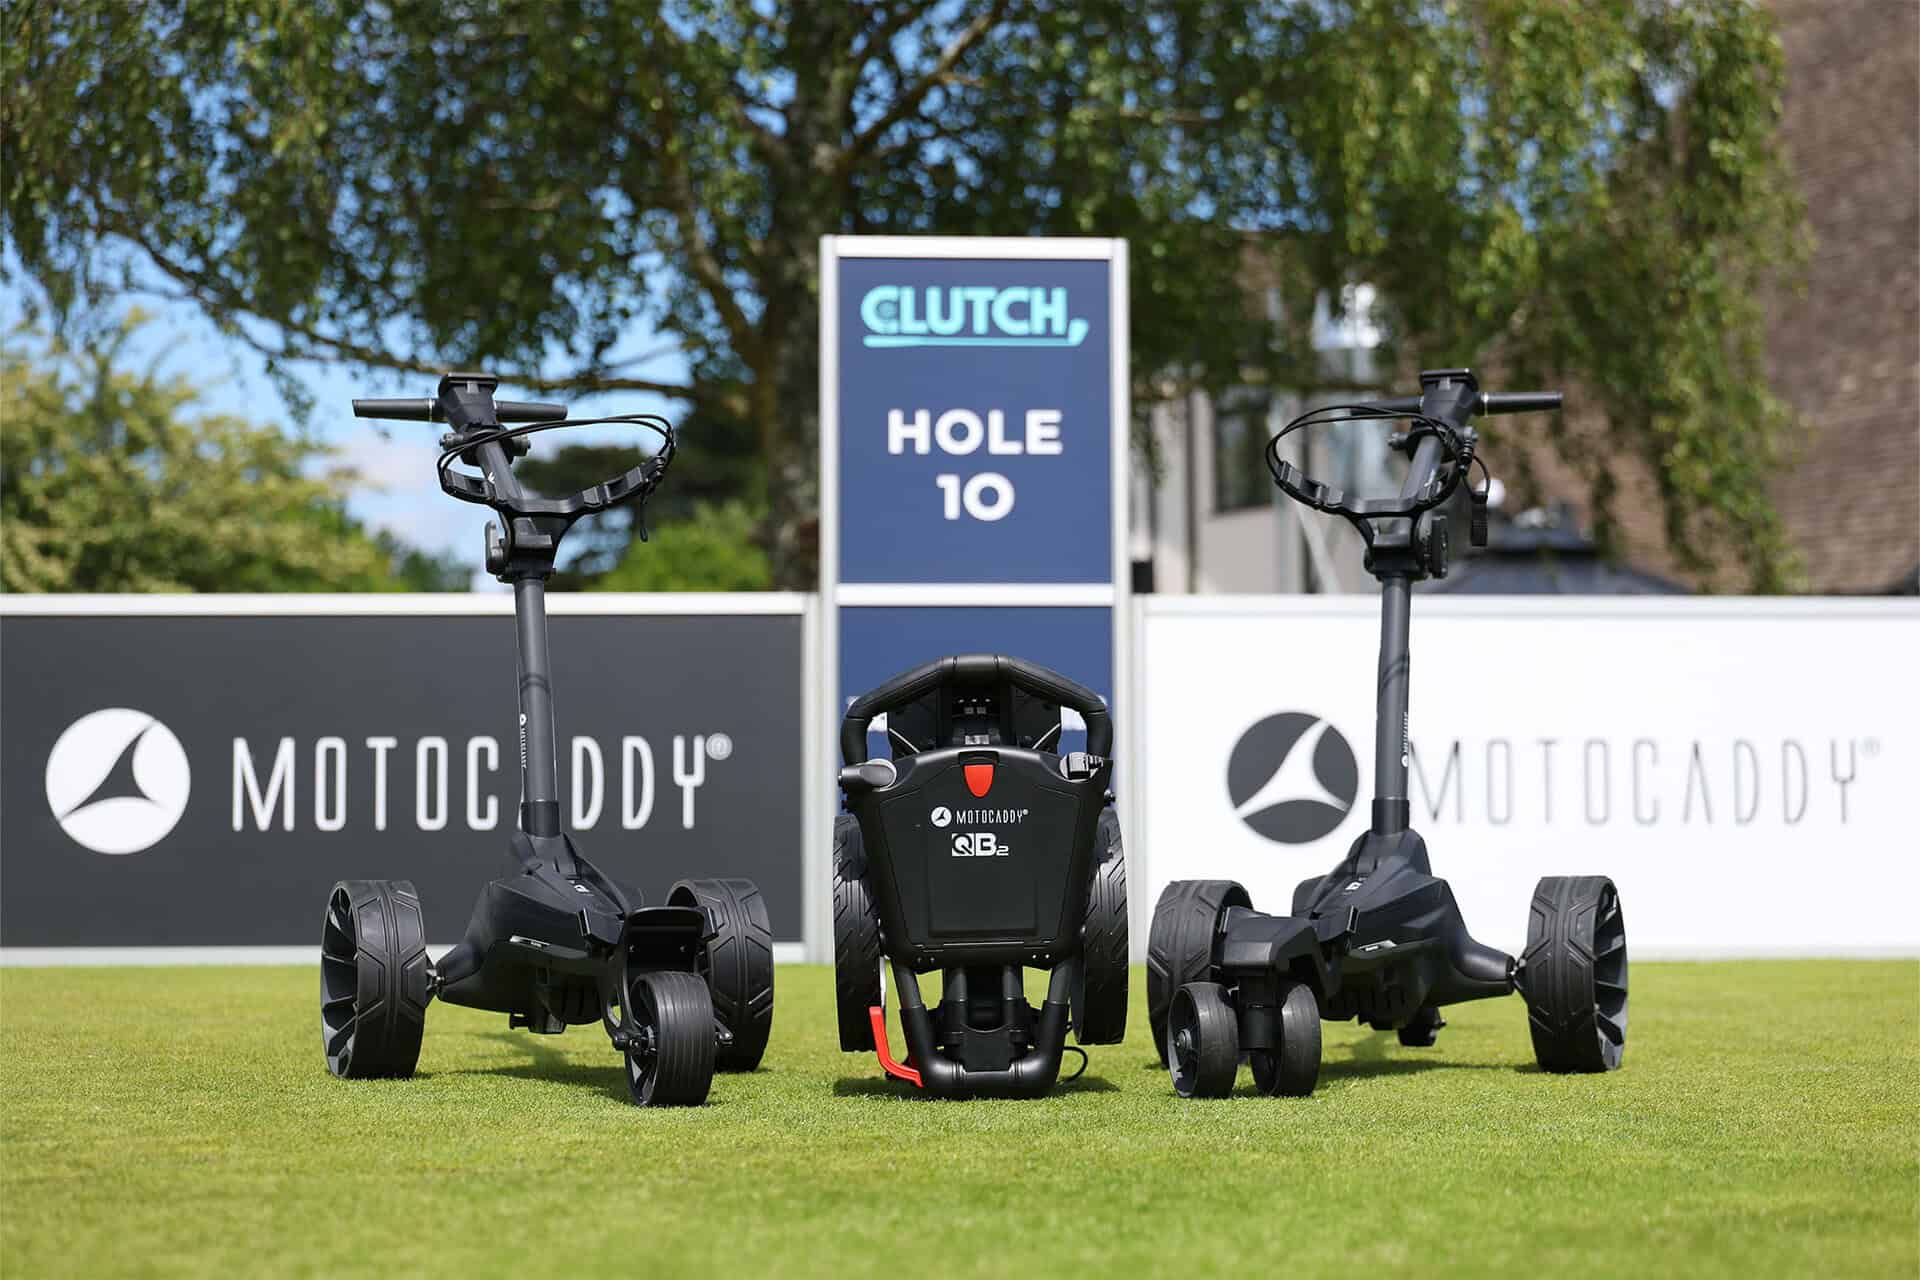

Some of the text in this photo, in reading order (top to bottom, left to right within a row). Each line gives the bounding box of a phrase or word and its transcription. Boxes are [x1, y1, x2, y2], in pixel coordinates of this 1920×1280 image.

[888, 409, 1063, 455] HOLE
[936, 472, 1015, 521] 10
[231, 735, 705, 830] MOTOCDDY
[956, 809, 1023, 824] MOTOCADDY
